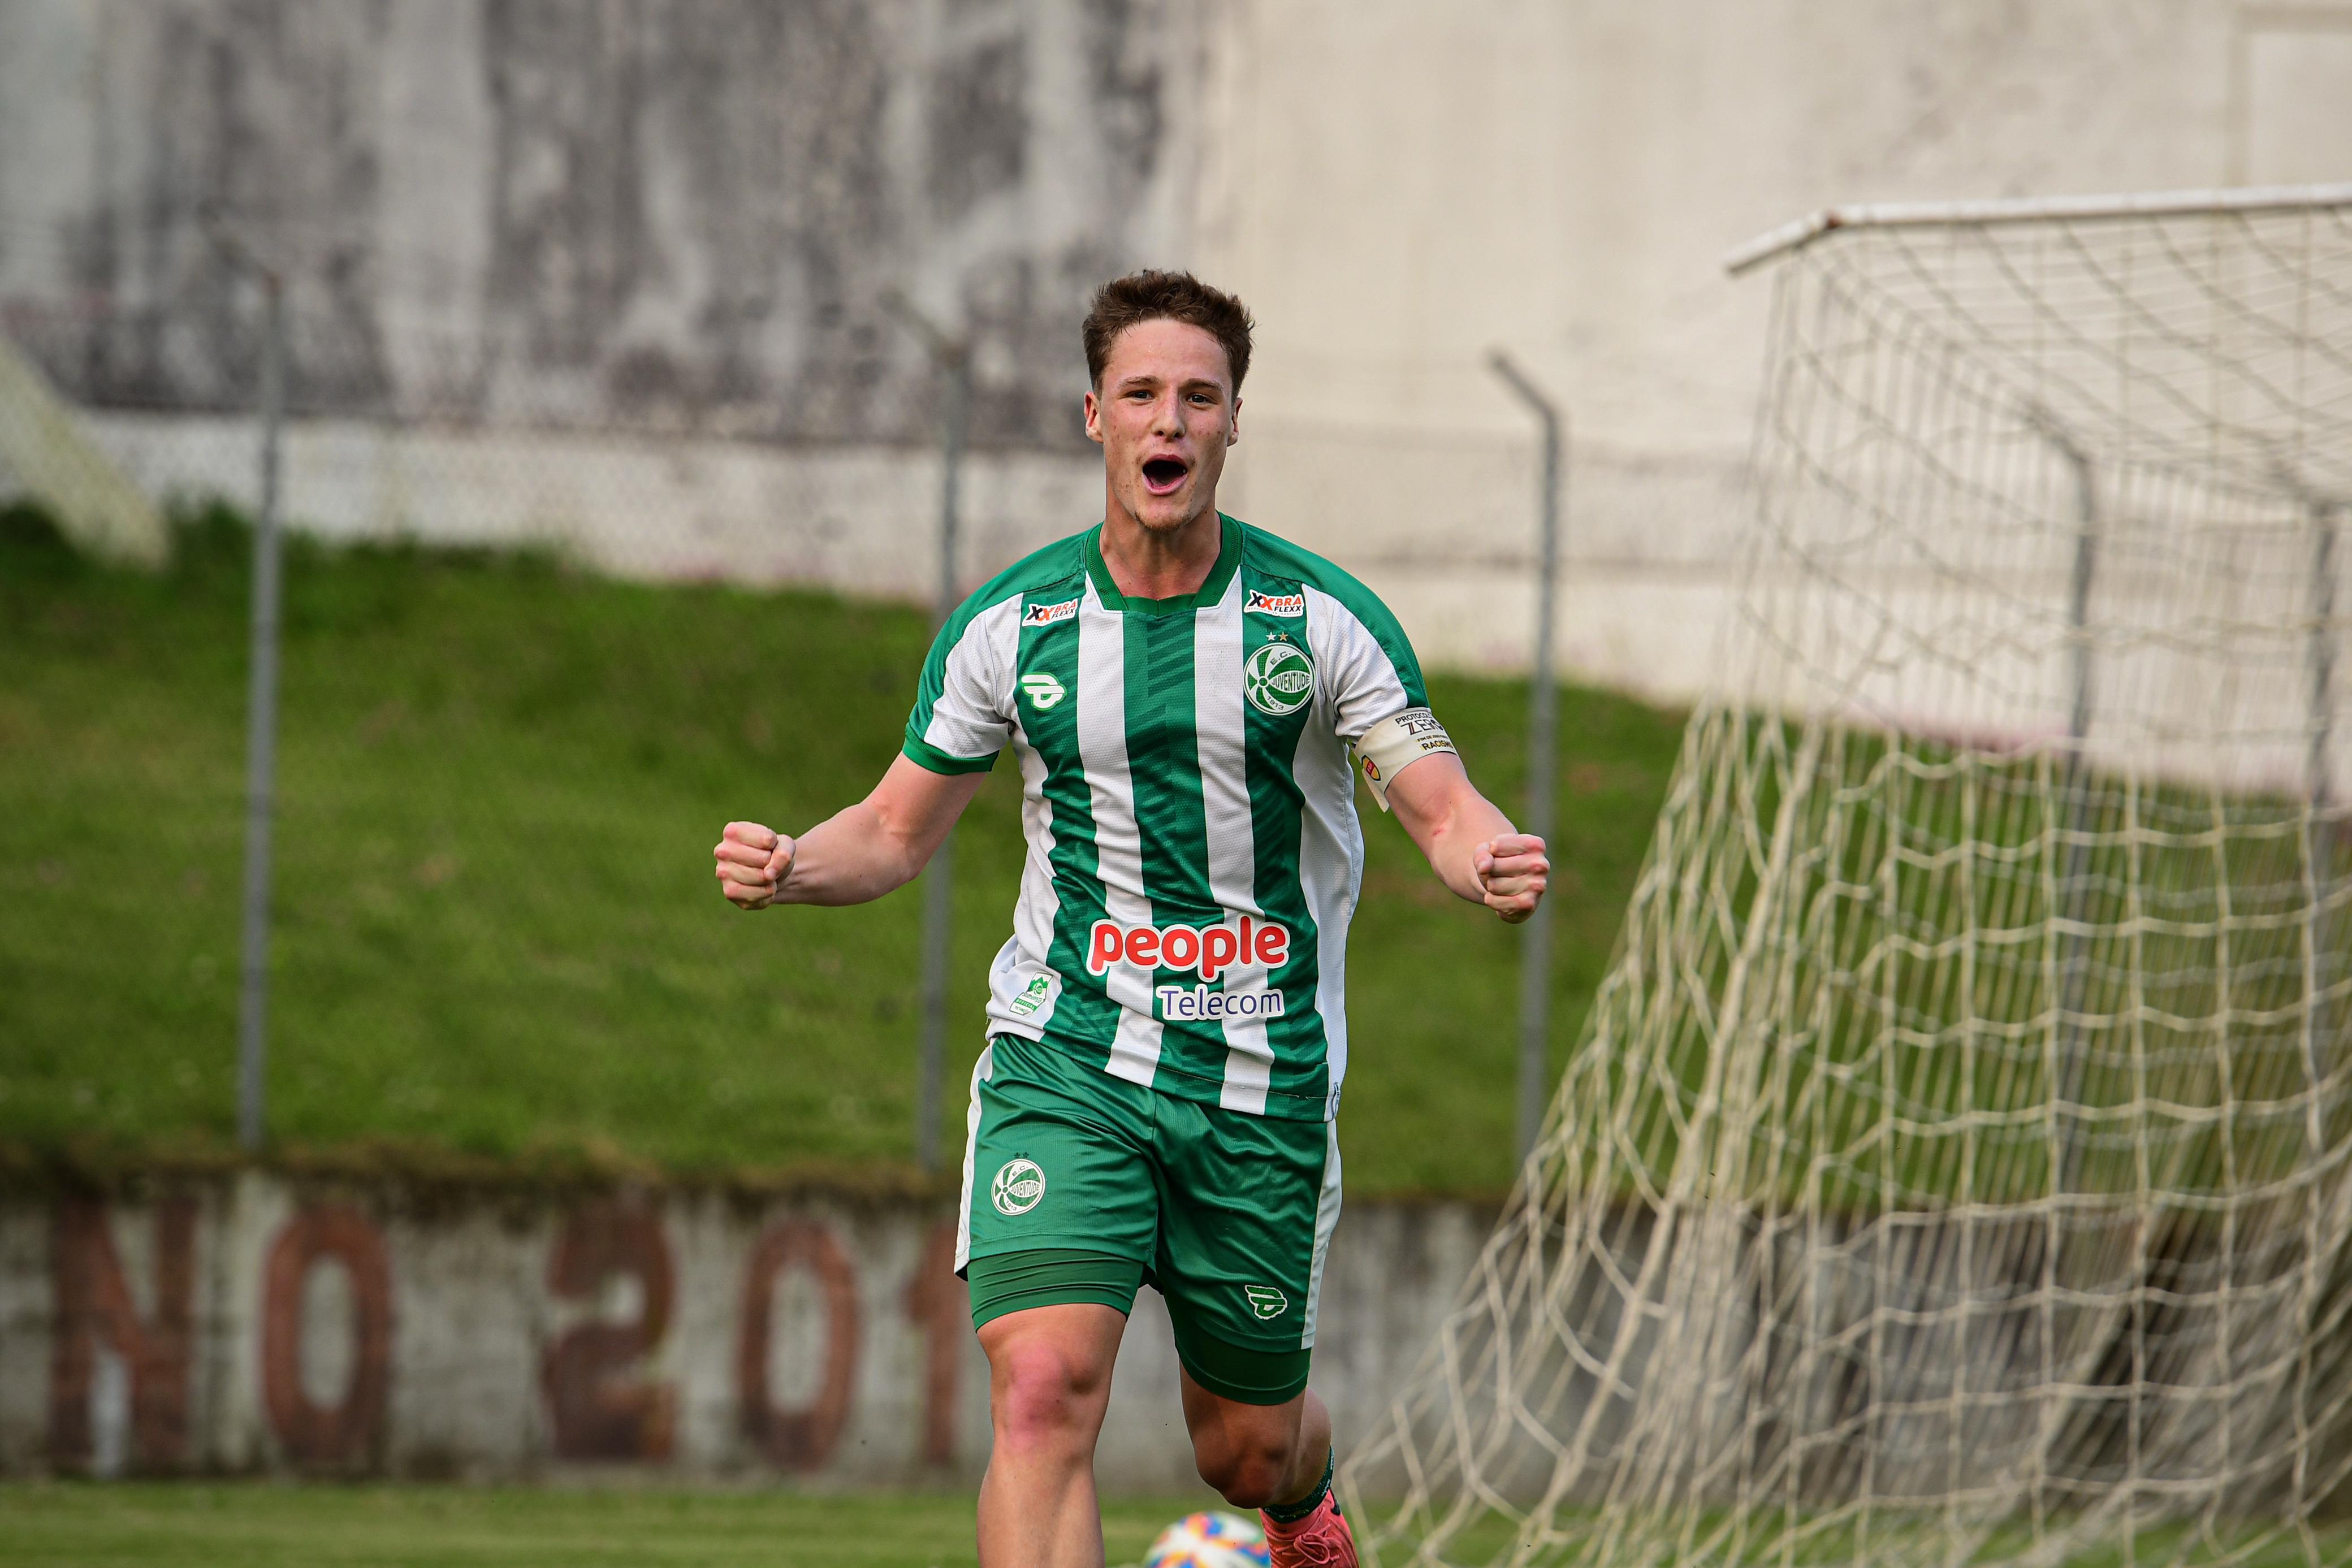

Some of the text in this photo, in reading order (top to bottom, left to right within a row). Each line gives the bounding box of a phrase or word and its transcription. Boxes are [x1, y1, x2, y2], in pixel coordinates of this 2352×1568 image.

[1051, 608, 1075, 620] FLEXX
[1272, 672, 1311, 691] JUVENTUDE
[1267, 696, 1285, 711] 1913
[1400, 719, 1443, 735] ZERO
[1091, 916, 1286, 978] people
[1160, 988, 1281, 1016] Telecom
[1010, 1181, 1040, 1197] JUVENTUDE
[1006, 1200, 1017, 1211] 1913
